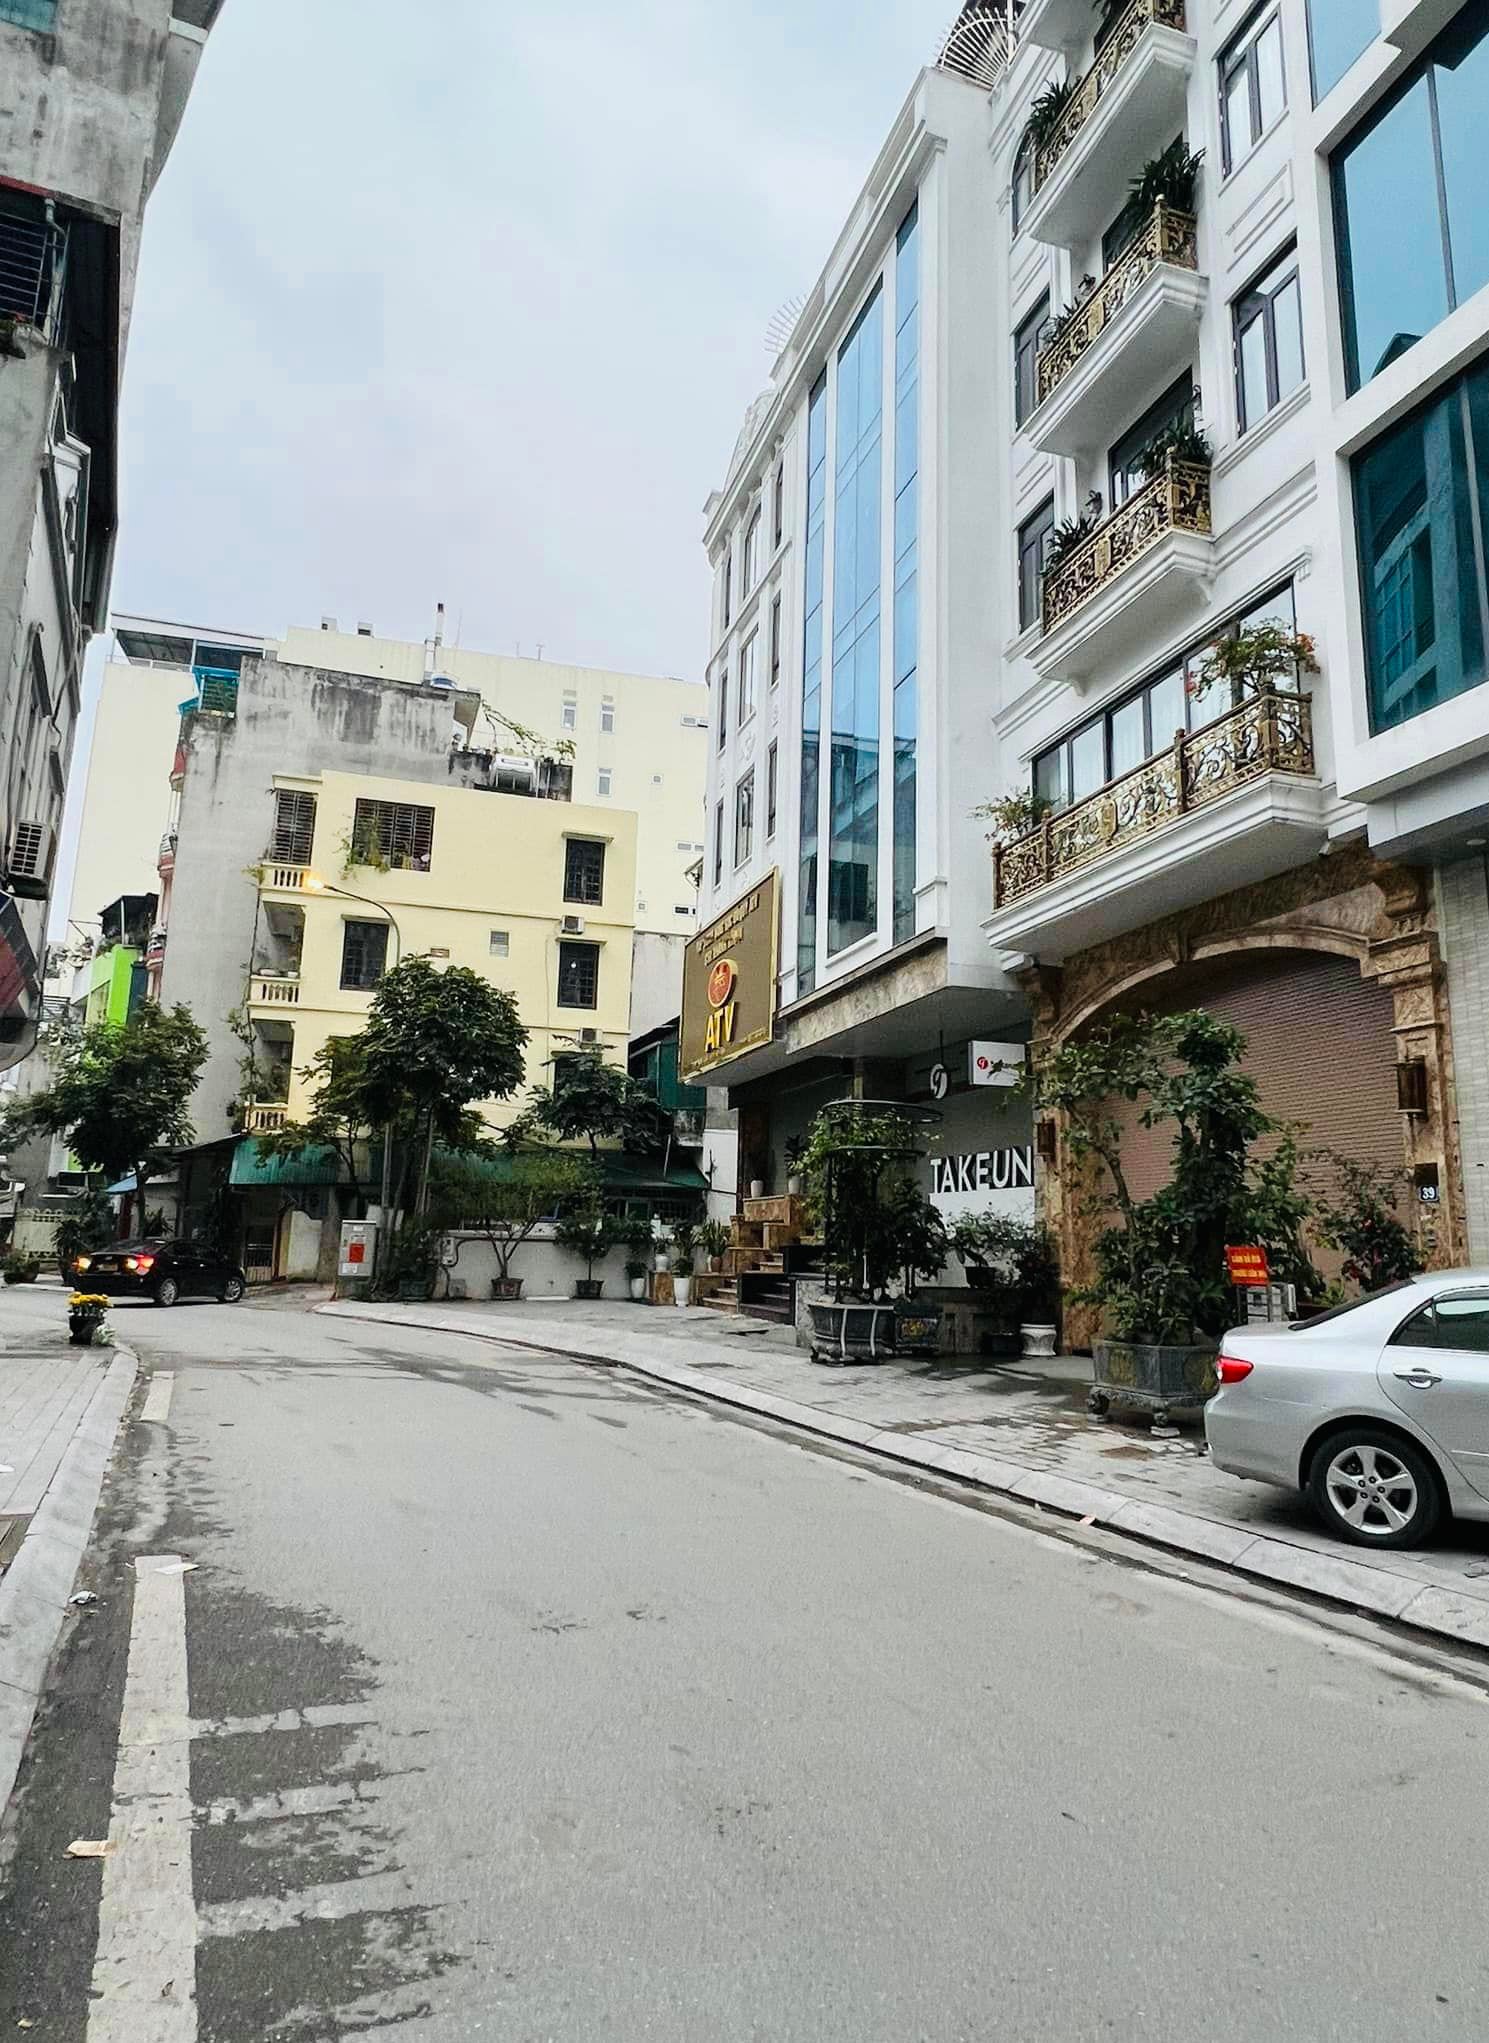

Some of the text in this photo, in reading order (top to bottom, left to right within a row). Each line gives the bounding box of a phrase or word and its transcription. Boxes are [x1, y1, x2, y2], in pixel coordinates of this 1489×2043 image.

[705, 1001, 736, 1052] ATV
[930, 1146, 1032, 1194] TAKEUN
[1422, 1186, 1435, 1200] 39
